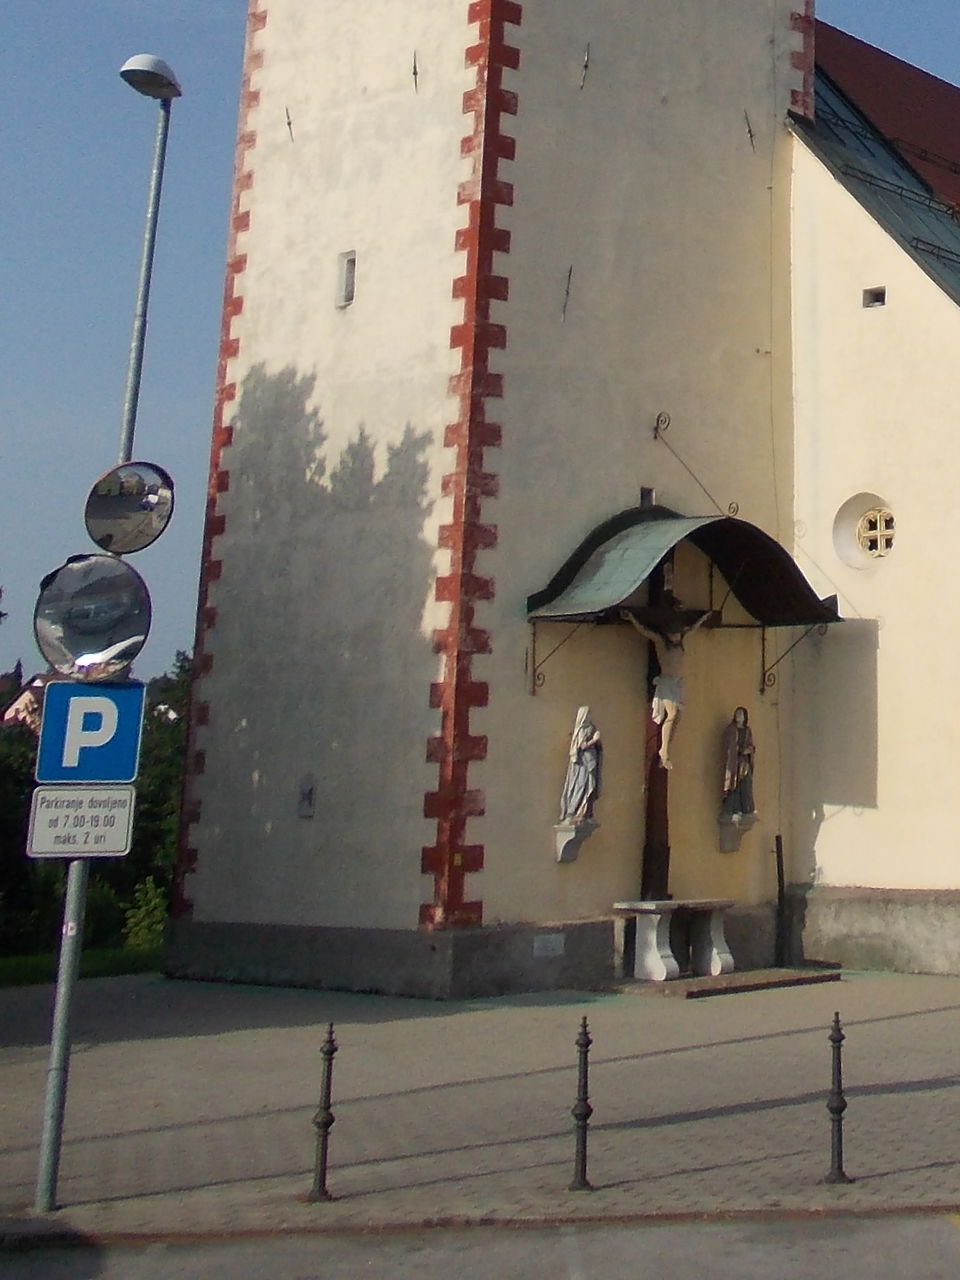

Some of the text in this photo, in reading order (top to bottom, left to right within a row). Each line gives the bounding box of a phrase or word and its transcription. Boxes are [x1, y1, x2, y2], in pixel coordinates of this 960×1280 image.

[62, 697, 118, 767] P
[39, 796, 128, 813] Parkiranje dovoljeno
[48, 816, 59, 828] od
[83, 831, 90, 845] 2
[94, 833, 106, 844] uri
